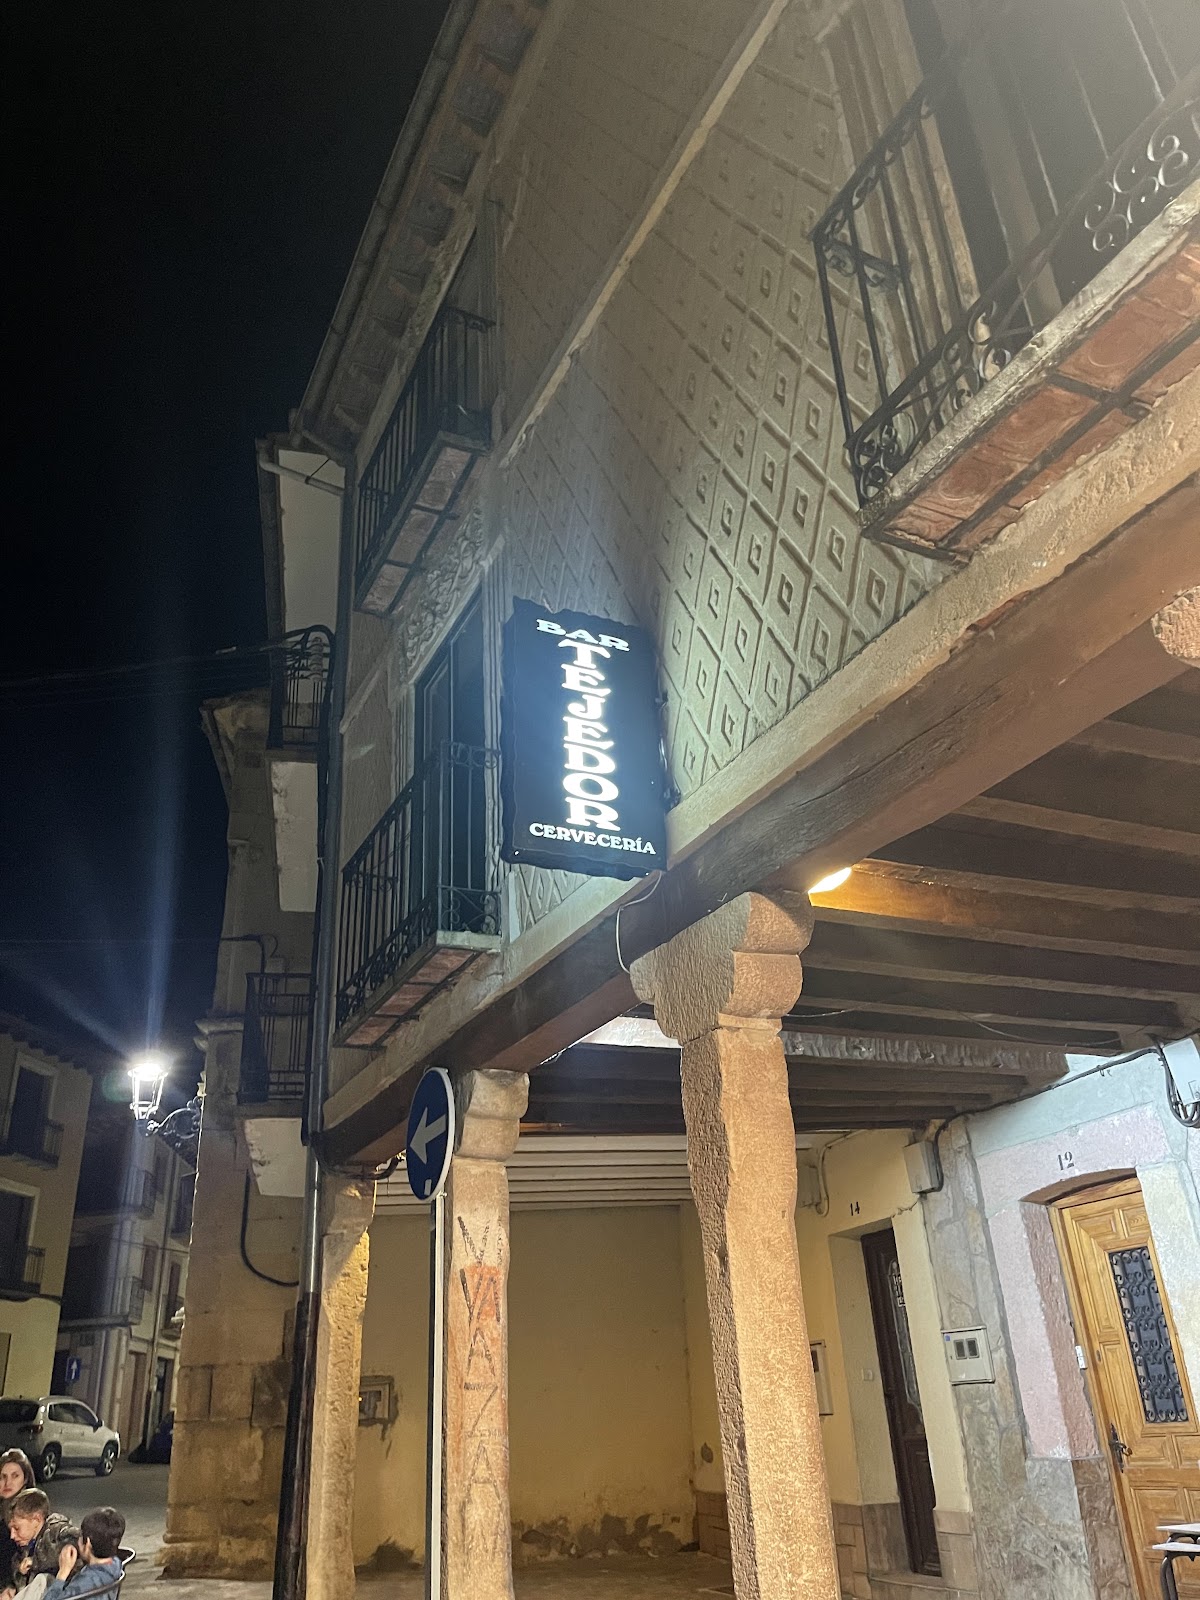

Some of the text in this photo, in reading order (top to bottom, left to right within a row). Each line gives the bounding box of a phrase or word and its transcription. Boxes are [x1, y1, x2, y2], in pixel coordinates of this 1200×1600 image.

[537, 619, 630, 651] BAR
[558, 639, 621, 831] TEJEDOR
[529, 823, 656, 854] CERVECERÍA
[1058, 1151, 1074, 1170] 12
[850, 1201, 860, 1216] 14
